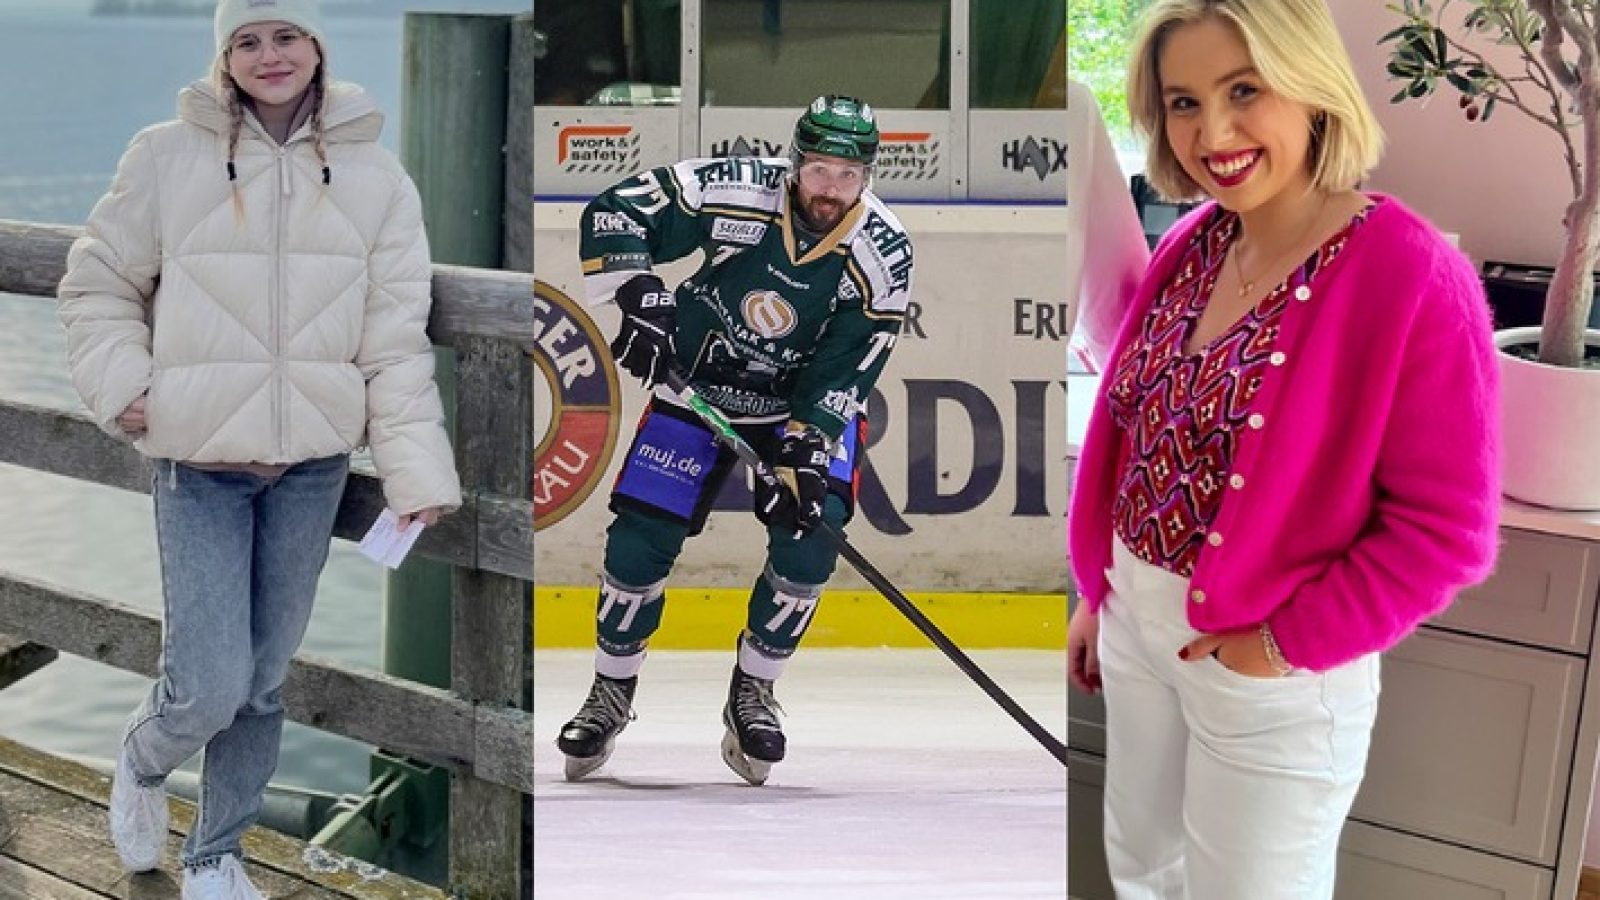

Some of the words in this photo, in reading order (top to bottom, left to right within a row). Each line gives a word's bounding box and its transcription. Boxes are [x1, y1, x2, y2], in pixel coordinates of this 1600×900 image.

[571, 137, 615, 147] work
[571, 149, 628, 163] safety
[534, 440, 590, 504] ÄU
[638, 443, 702, 477] muj.de
[597, 584, 645, 632] 77
[764, 590, 818, 637] 77
